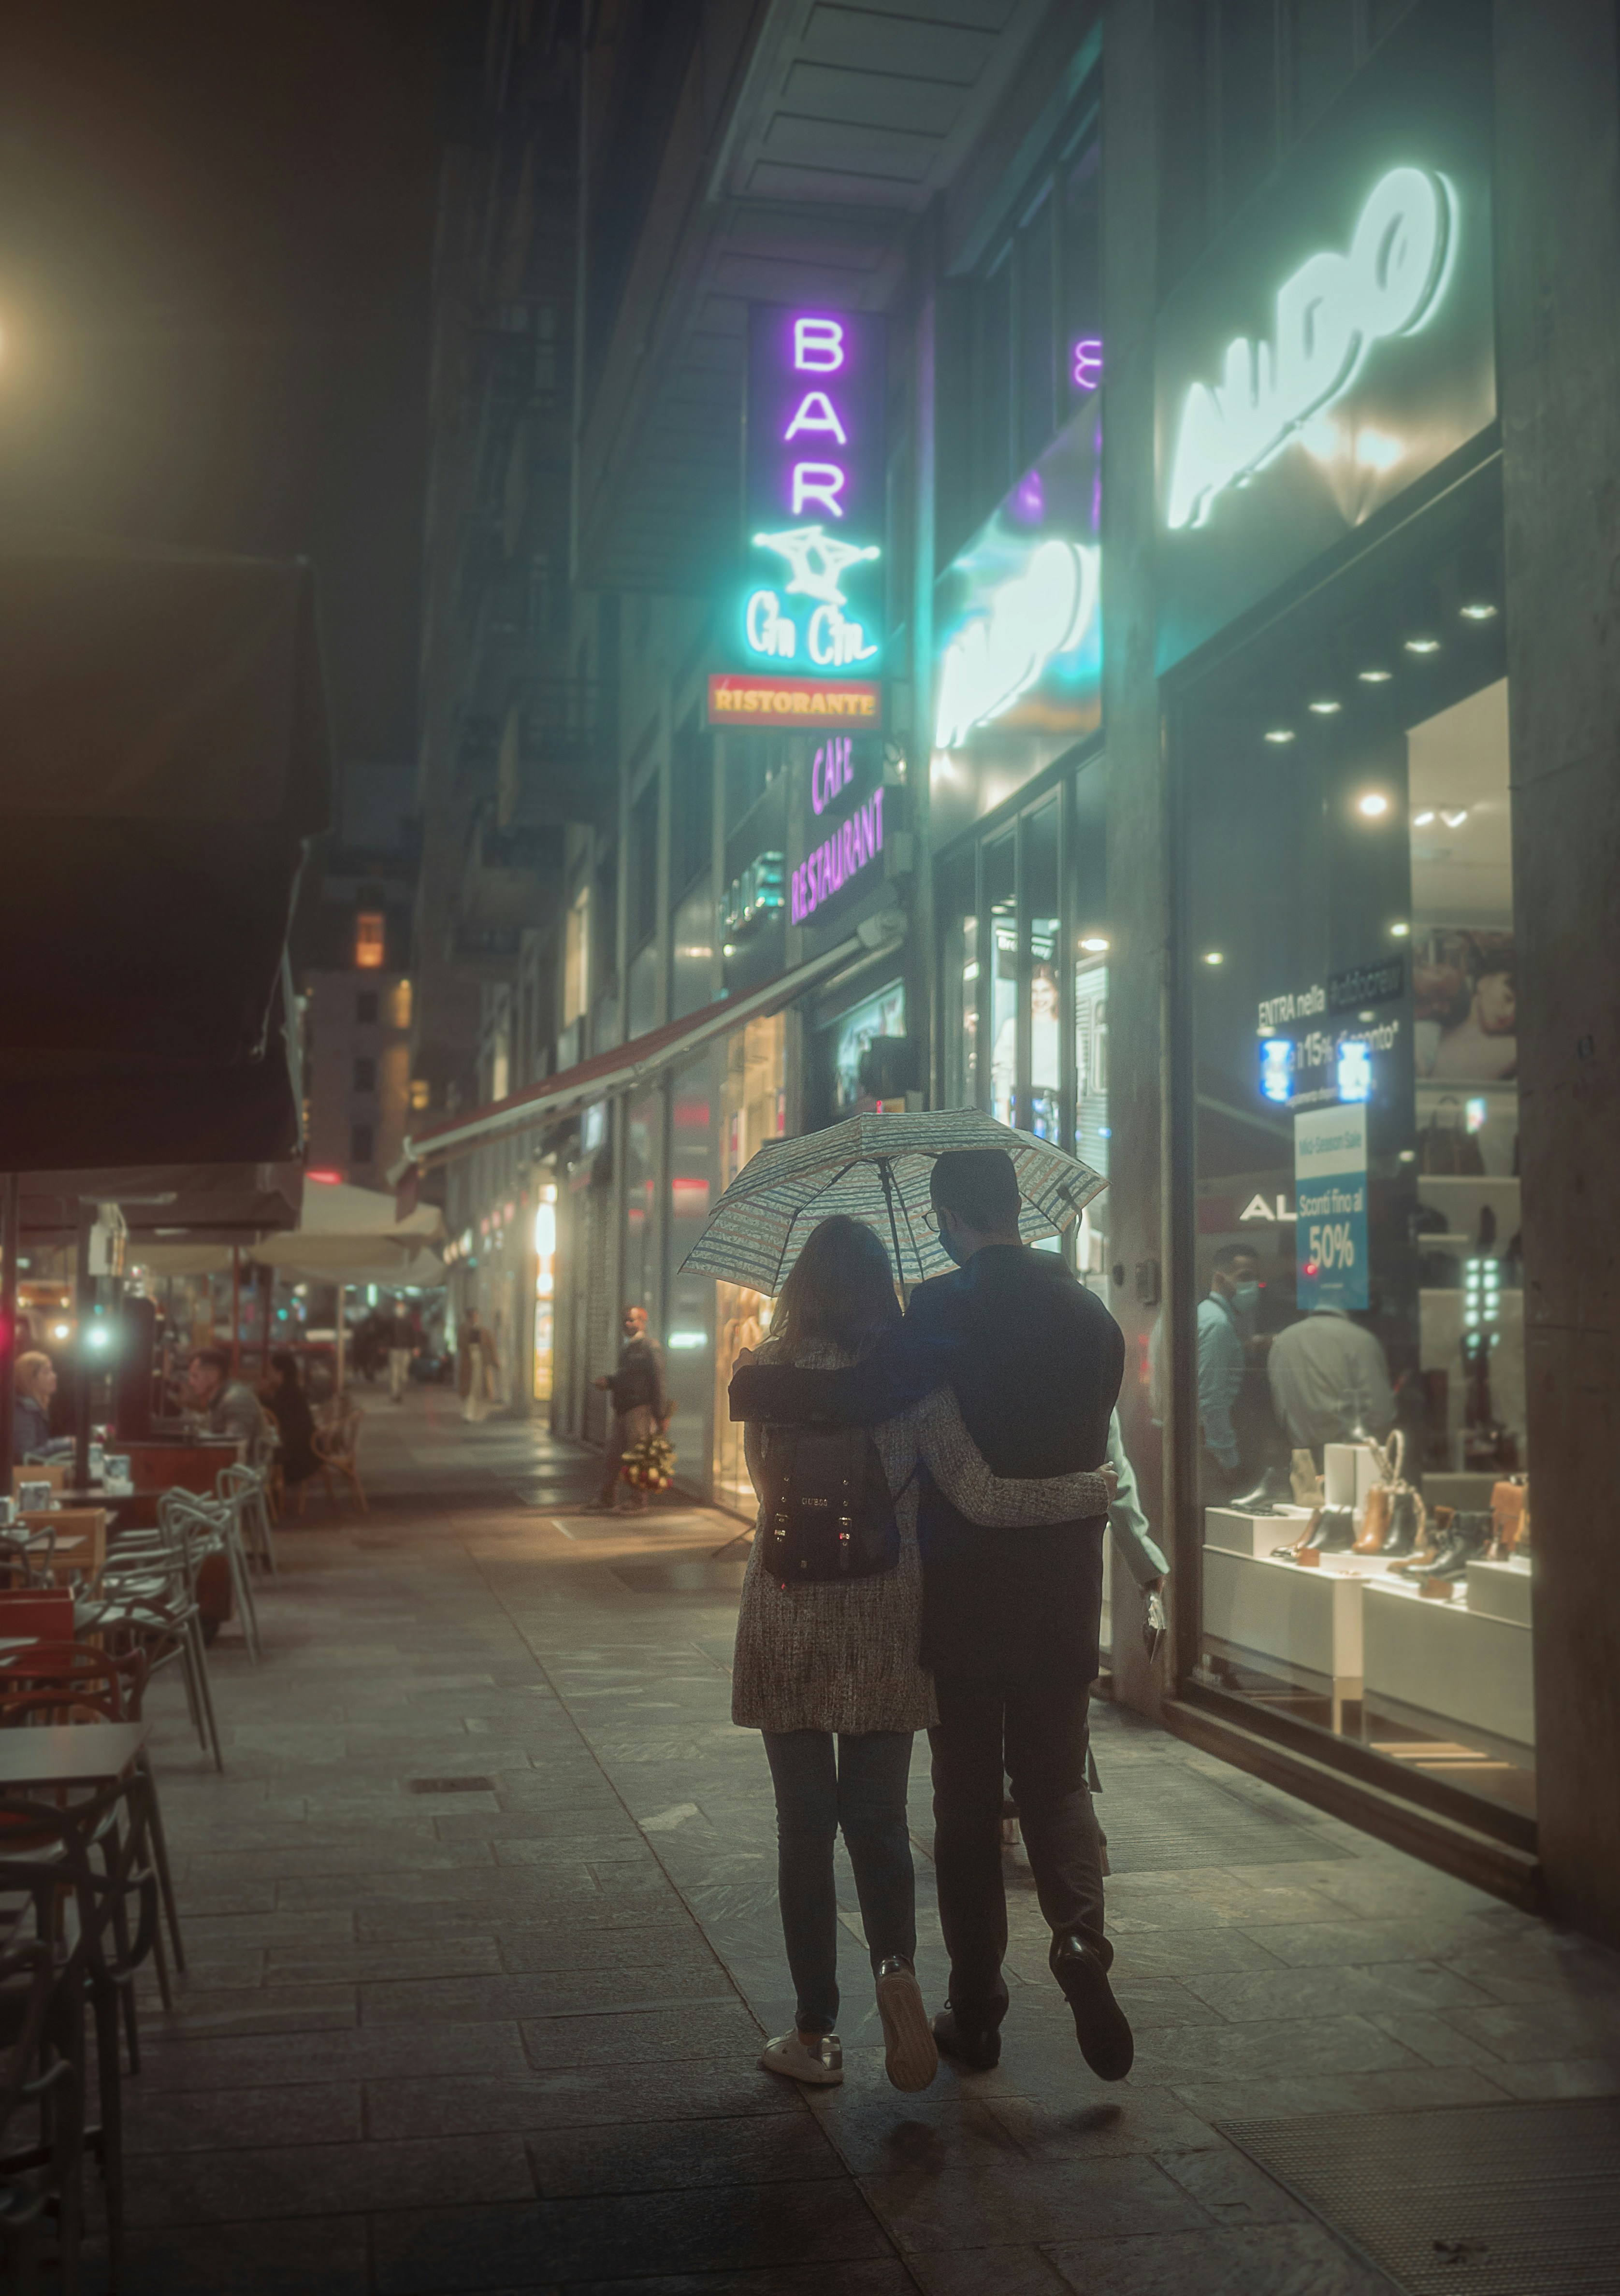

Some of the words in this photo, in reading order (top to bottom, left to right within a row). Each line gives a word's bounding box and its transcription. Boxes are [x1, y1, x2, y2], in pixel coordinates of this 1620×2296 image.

[784, 318, 847, 517] BAR
[714, 689, 876, 716] RISTORANTE
[812, 735, 854, 816] CAFE
[791, 786, 884, 926] RESTAURANT
[1258, 993, 1295, 1028] ENTRA
[1297, 984, 1325, 1018] nella
[1239, 1193, 1298, 1221] AL
[1299, 1189, 1331, 1218] Sconti
[1332, 1188, 1352, 1213] fino
[1353, 1187, 1363, 1212] al
[1309, 1222, 1355, 1270] 50%
